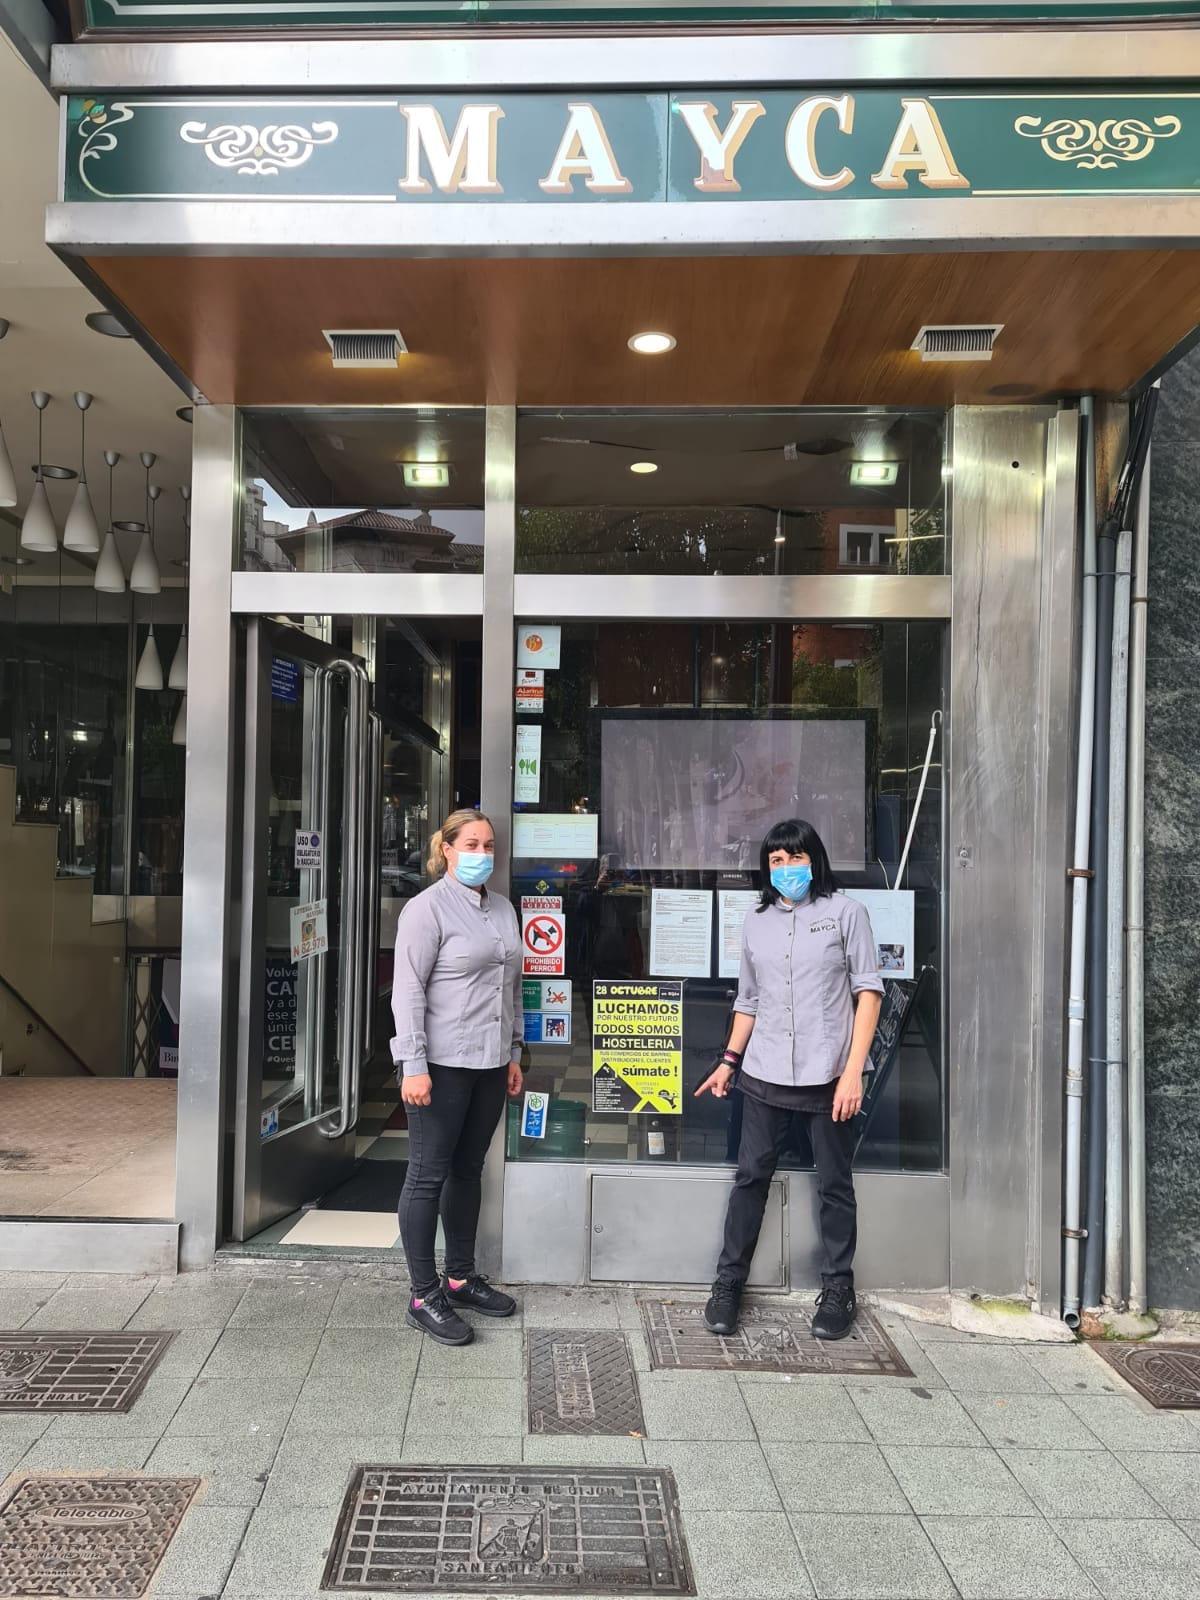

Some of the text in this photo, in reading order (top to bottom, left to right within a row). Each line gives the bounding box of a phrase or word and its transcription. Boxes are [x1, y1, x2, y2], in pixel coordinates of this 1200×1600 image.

[398, 93, 971, 194] MAYCA
[297, 836, 308, 846] USO
[296, 849, 320, 857] OBLIGATORIO
[810, 923, 836, 933] MAYCA
[526, 957, 561, 965] PROHIBIDO
[530, 964, 556, 972] PERROS
[595, 985, 658, 996] 28 OCTUBRE
[597, 1003, 680, 1015] LUCHAMOS
[267, 1011, 289, 1021] ese
[594, 1023, 680, 1035] TODOS SOMOS
[602, 1038, 675, 1049] HOSTELERIA
[622, 1065, 678, 1077] súmate !
[402, 1483, 617, 1497] AYUNTAMIENTO DE GIJON
[51, 1506, 135, 1518] Telecable
[443, 1562, 576, 1575] SANEAMIENTO
